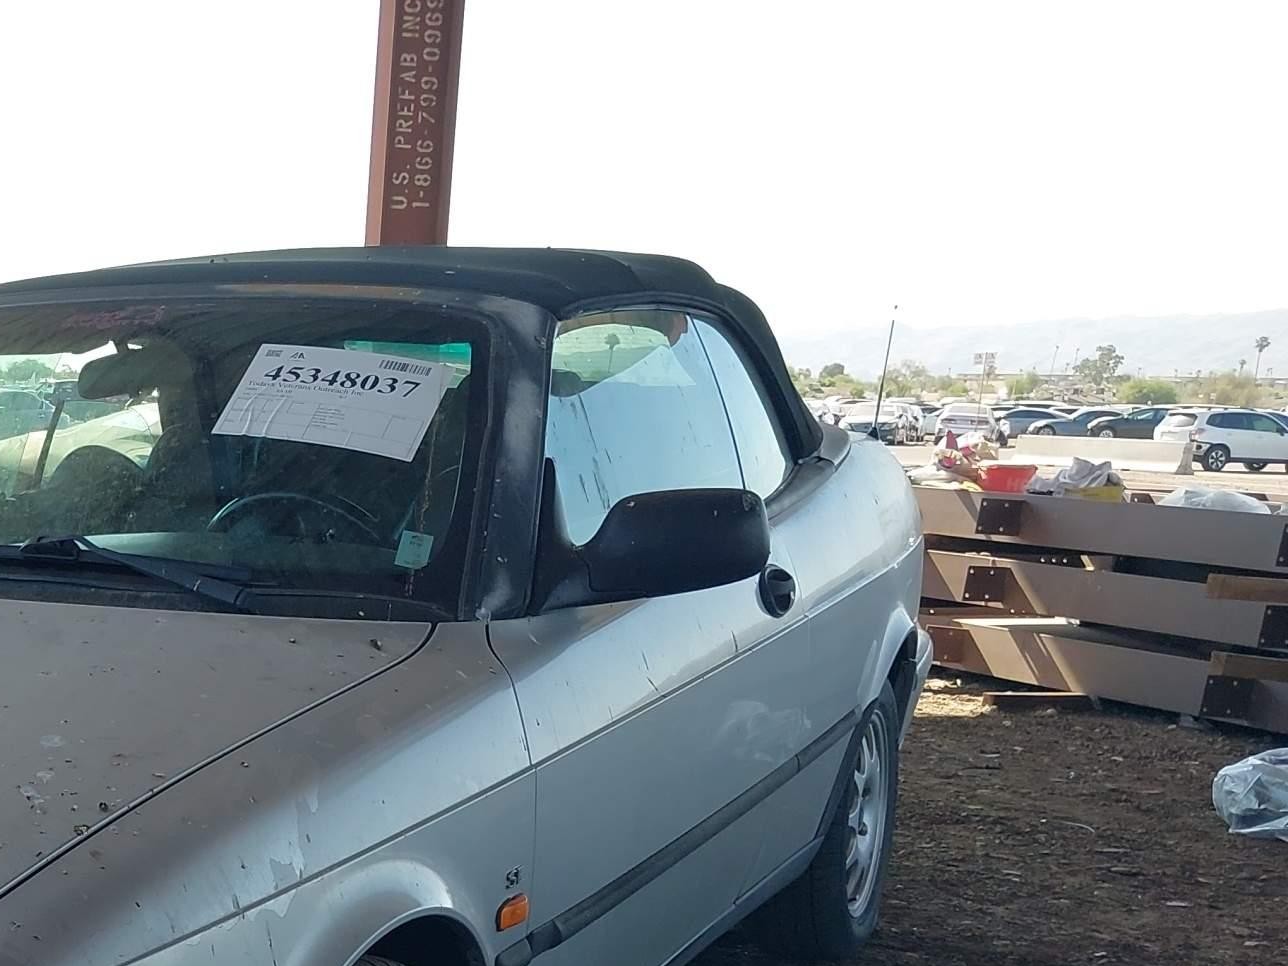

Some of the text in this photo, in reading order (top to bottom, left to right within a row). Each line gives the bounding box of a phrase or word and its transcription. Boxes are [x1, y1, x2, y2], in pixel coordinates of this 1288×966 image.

[394, 52, 418, 149] PREFAB
[390, 163, 411, 210] U.S.
[263, 364, 422, 398] 45348037
[313, 385, 349, 395] Outreach
